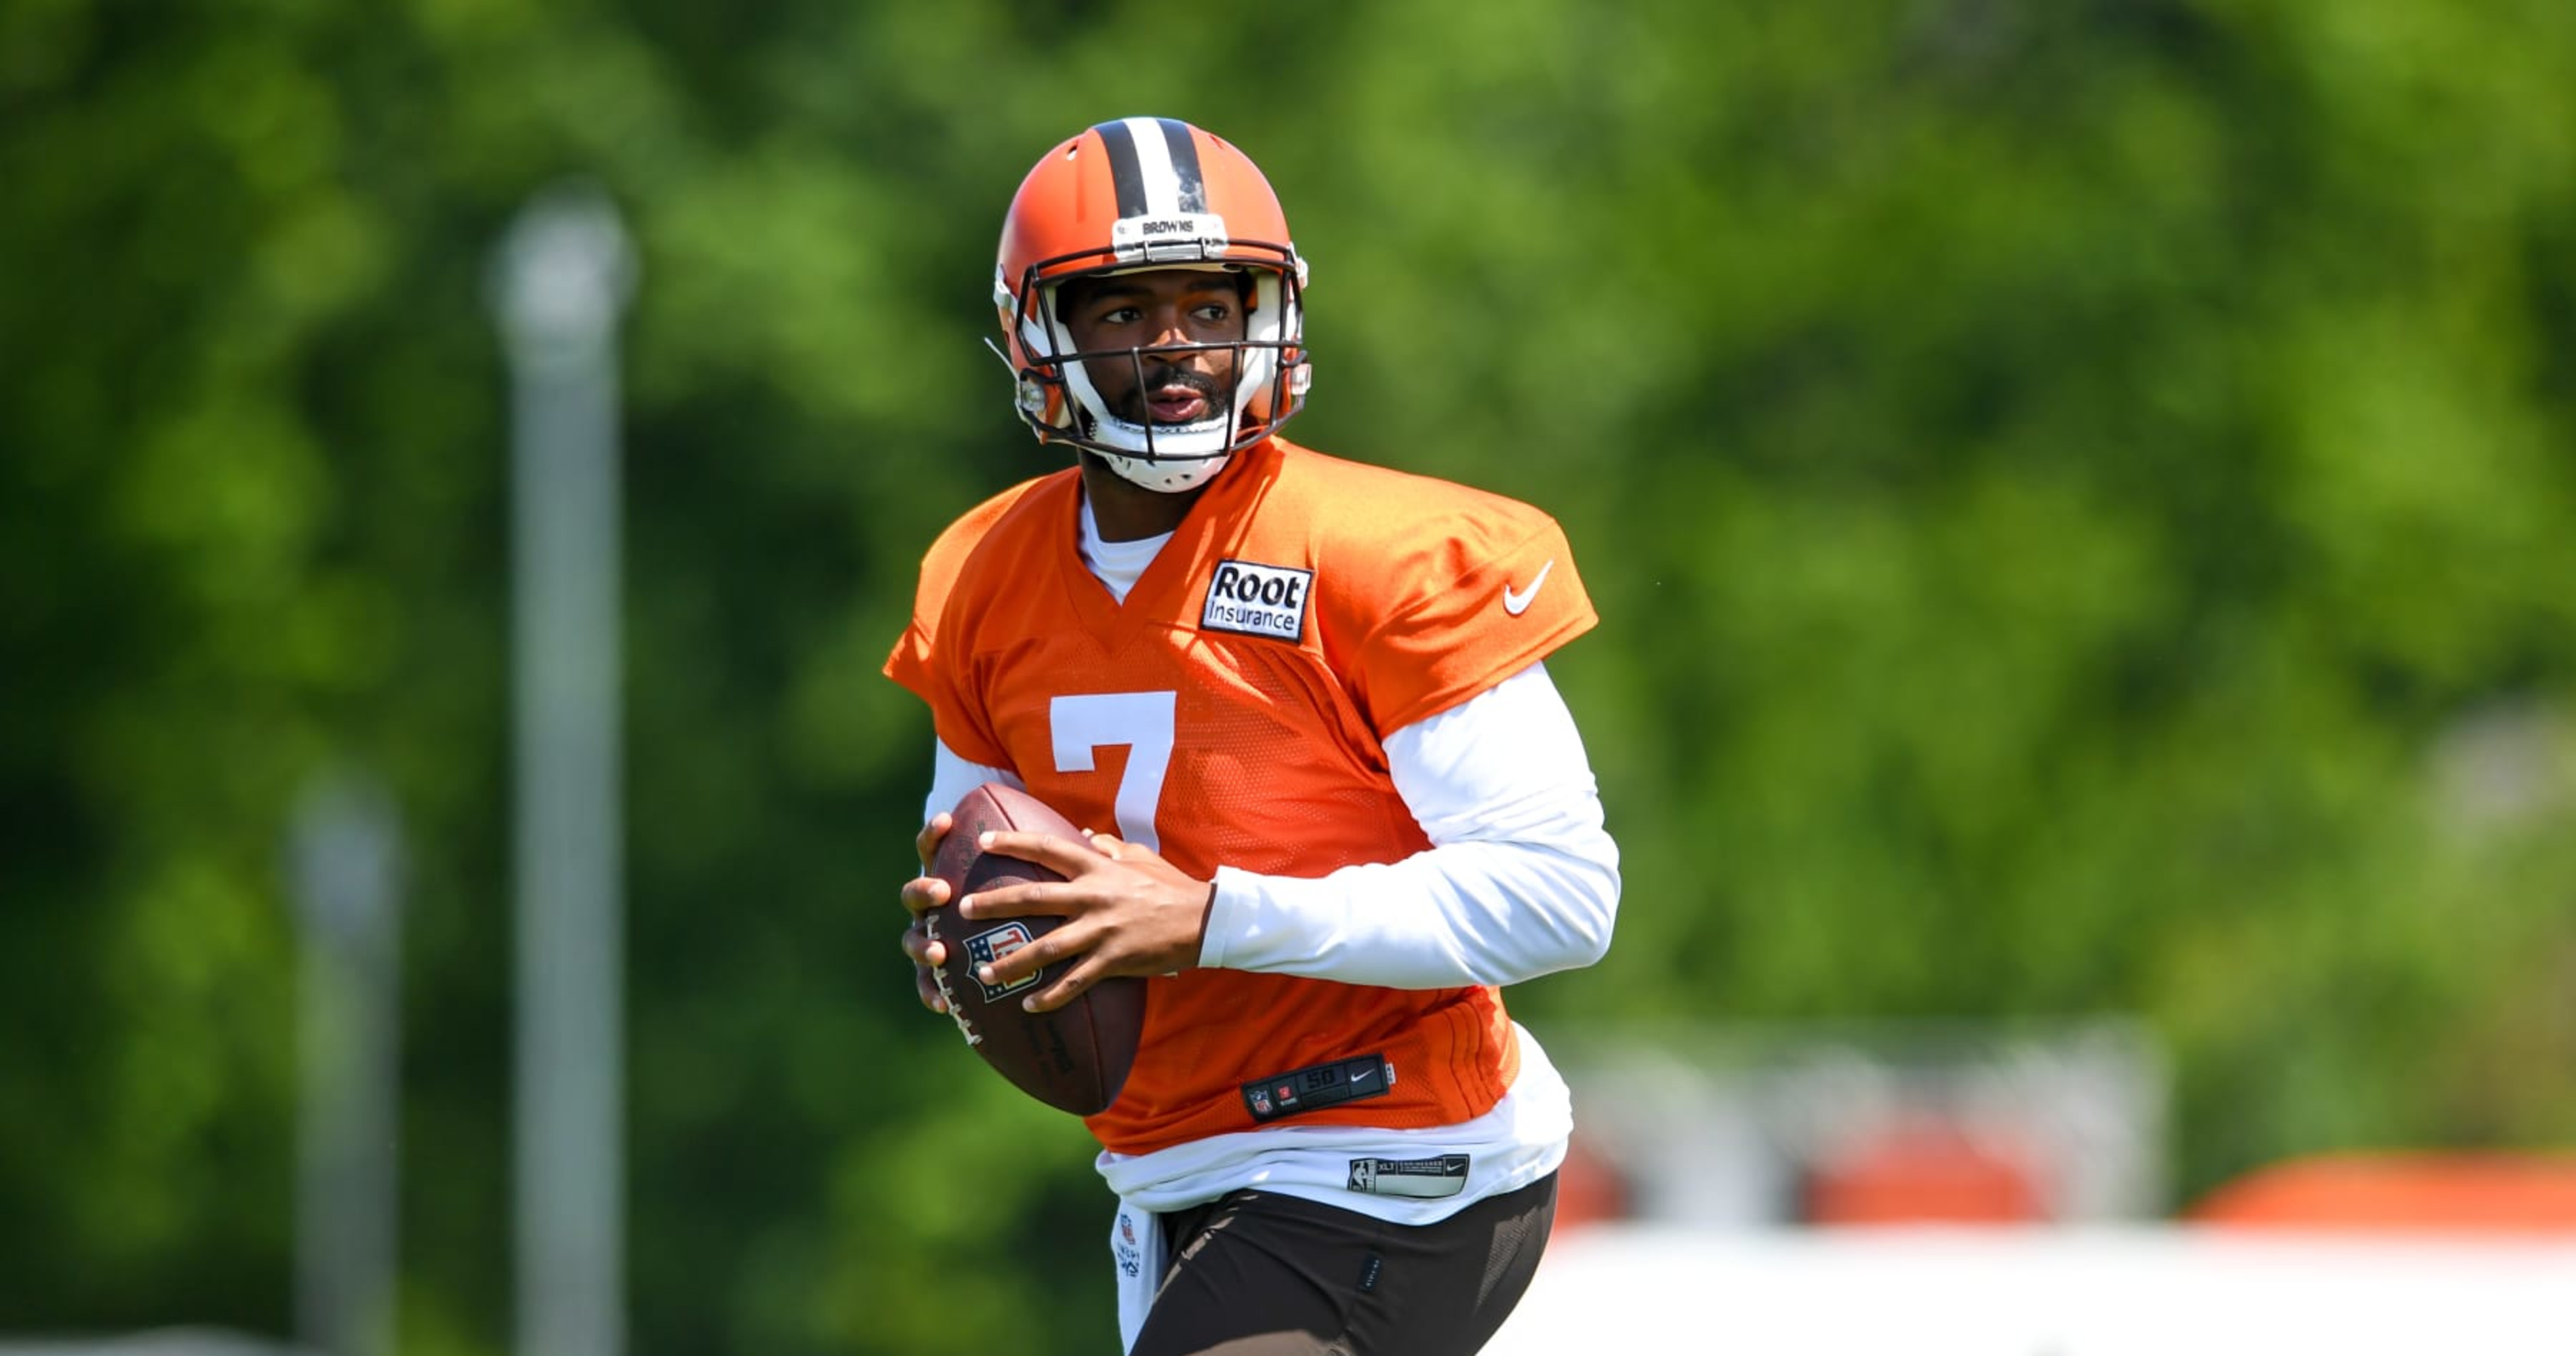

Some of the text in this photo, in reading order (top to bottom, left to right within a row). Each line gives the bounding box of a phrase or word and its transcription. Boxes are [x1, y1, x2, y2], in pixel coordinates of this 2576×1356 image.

[1142, 220, 1194, 235] BROWNS
[1214, 567, 1300, 609] Root
[1209, 600, 1295, 631] Insurance
[1049, 690, 1177, 856] 7
